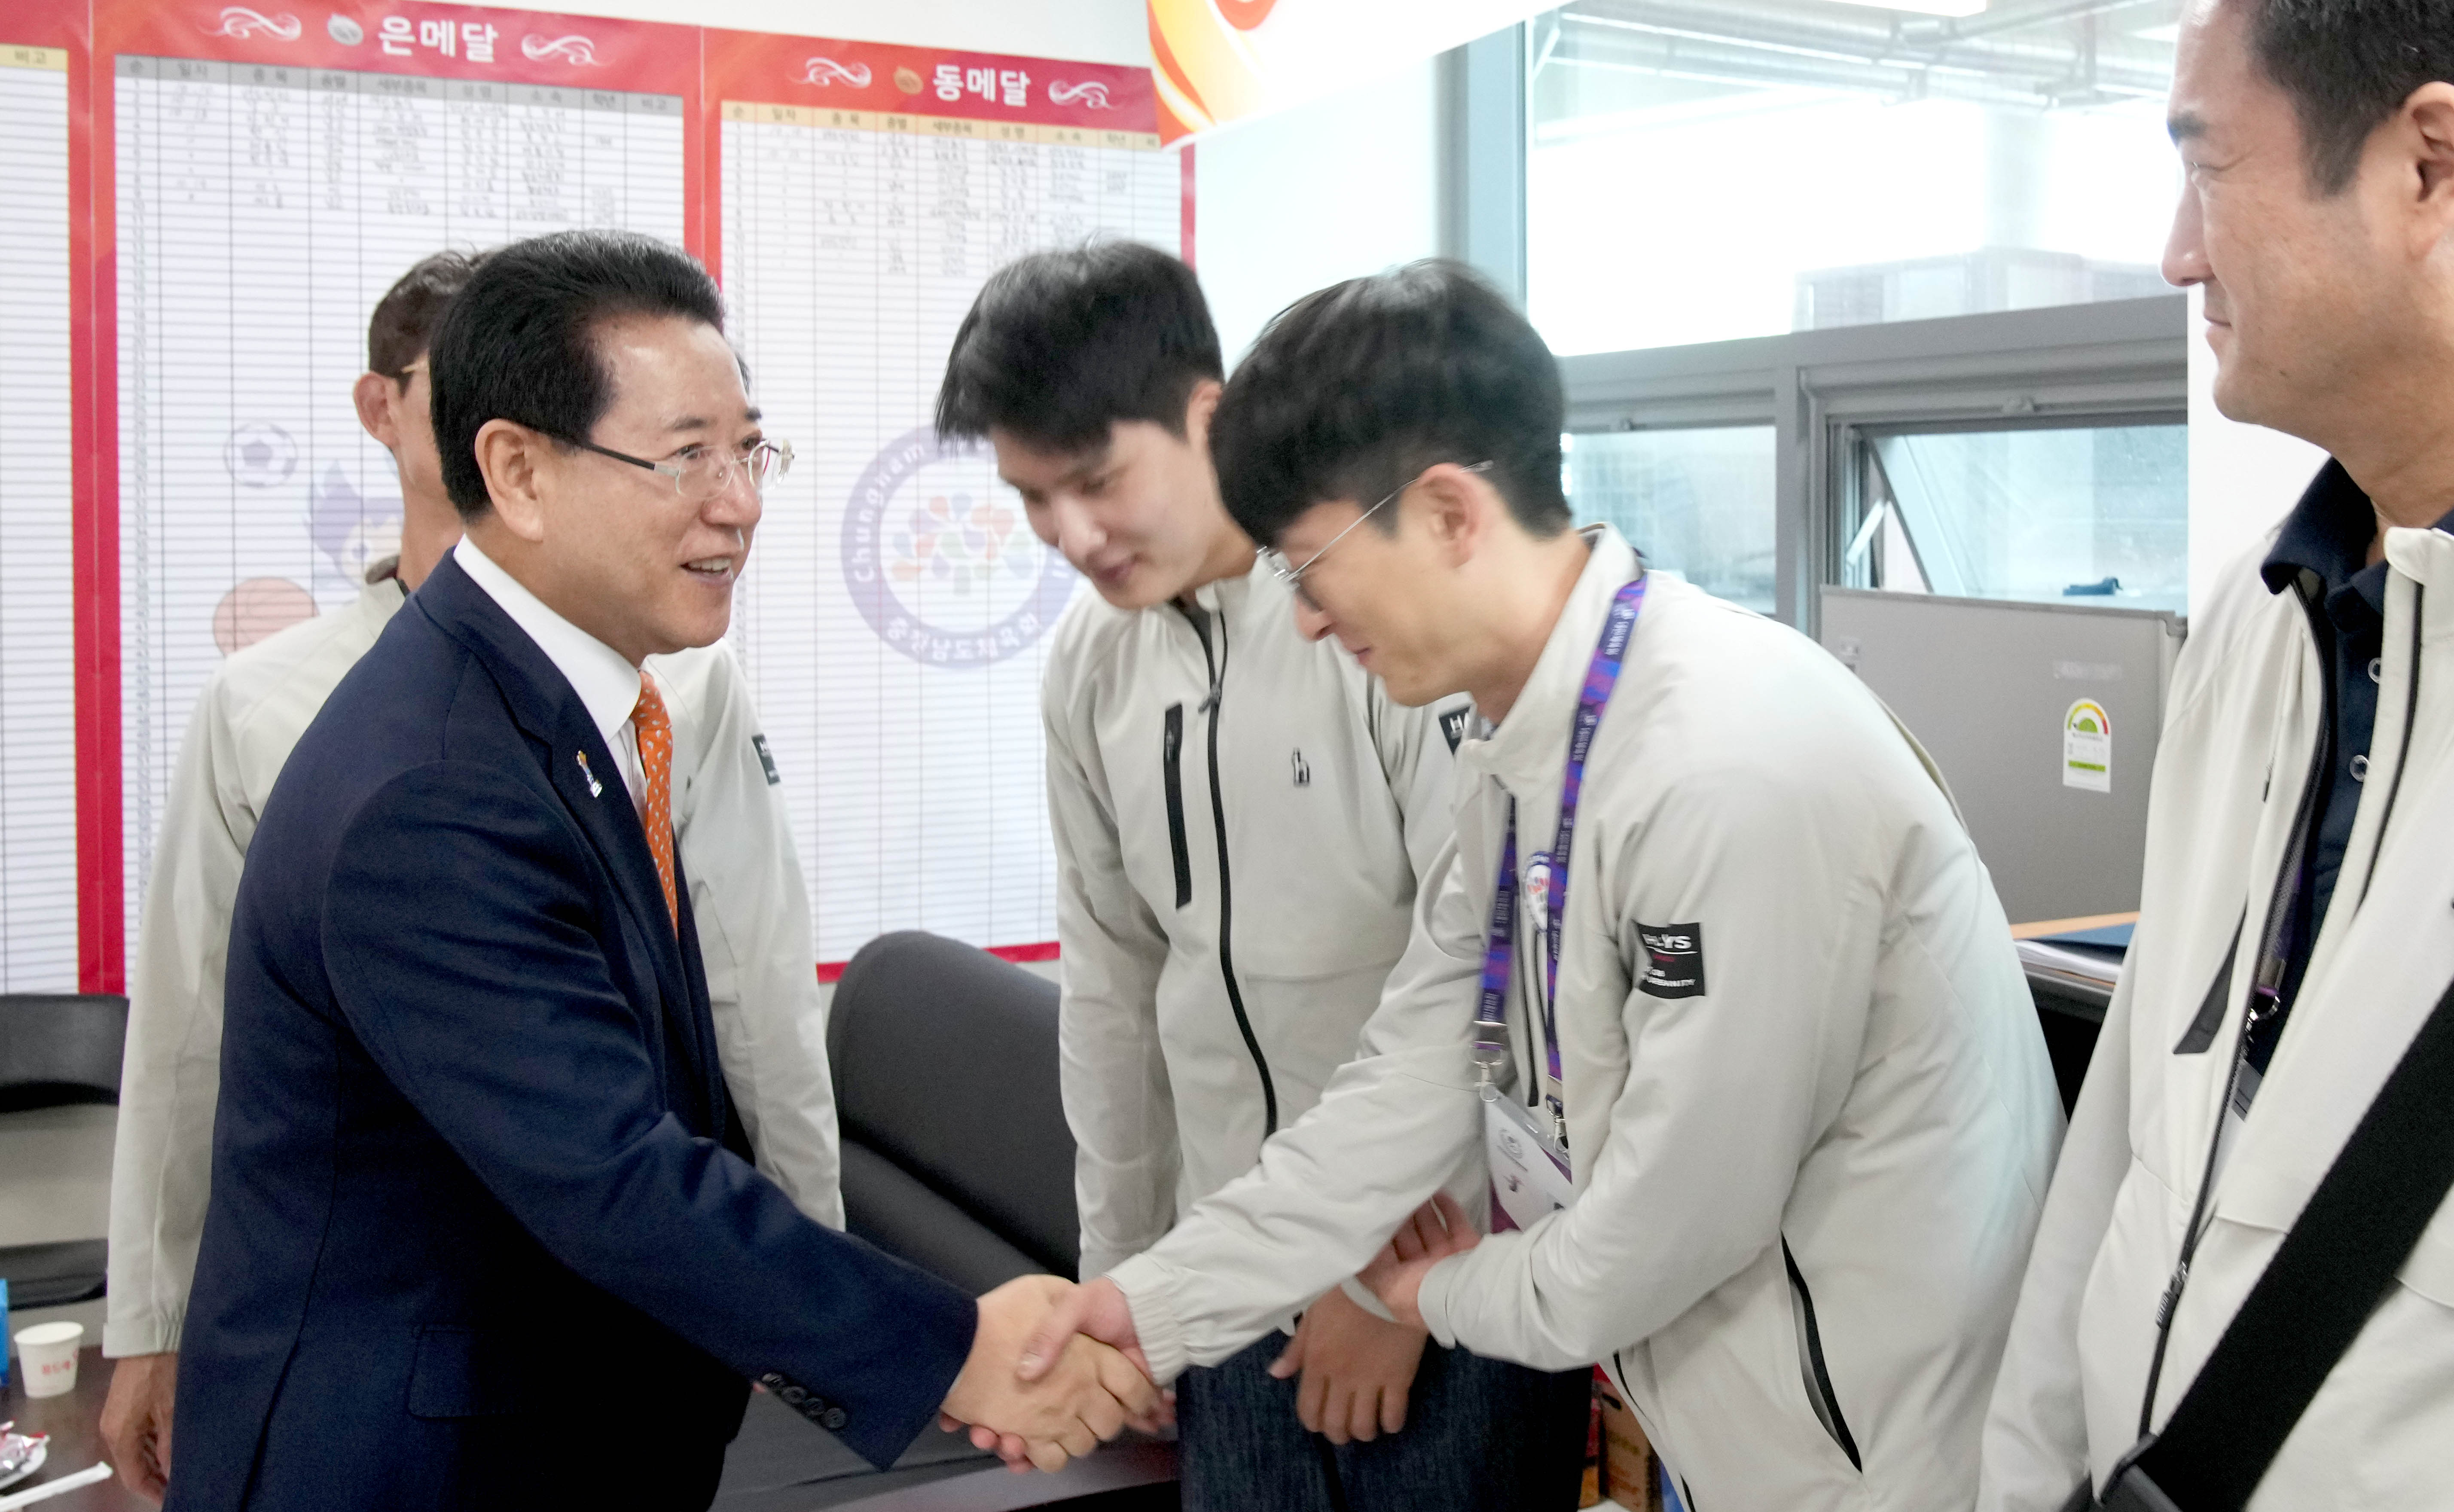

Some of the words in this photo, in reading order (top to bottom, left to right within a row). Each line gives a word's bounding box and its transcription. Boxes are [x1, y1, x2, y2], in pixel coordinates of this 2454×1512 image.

[378, 15, 499, 63] 은메달
[932, 64, 1031, 107] 동메달
[852, 443, 925, 582] Chungnam
